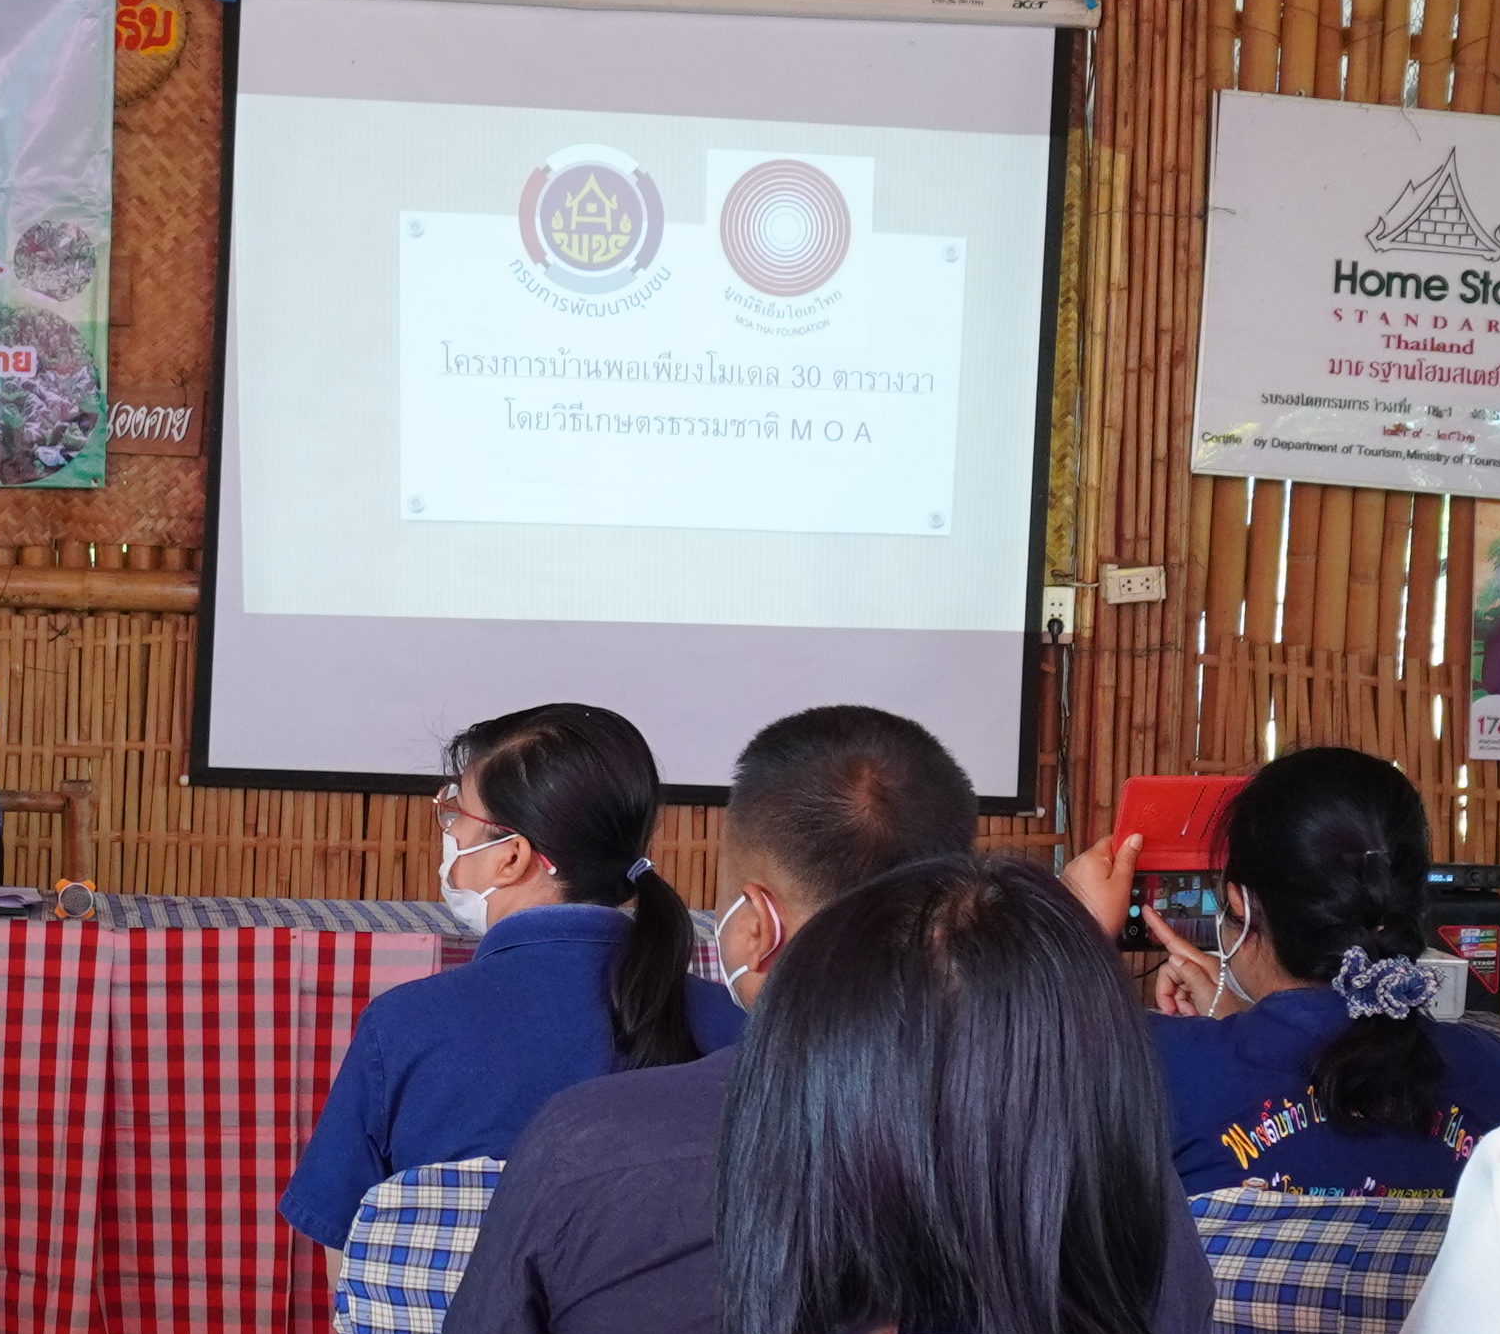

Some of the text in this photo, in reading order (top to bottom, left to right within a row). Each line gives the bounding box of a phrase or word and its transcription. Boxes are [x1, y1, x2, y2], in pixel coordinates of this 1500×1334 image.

[508, 256, 673, 317] กรมการพัฒนาชุมชน
[1333, 259, 1450, 303] Home
[1382, 333, 1475, 356] Thailand
[440, 340, 935, 395] โครงการบ้านพอเพียงโมเดล 30 ตารางวา
[504, 397, 780, 440] โดยวิธีเกษตรธรรมชาติ
[1201, 430, 1243, 447] Certifie
[1271, 437, 1338, 455] Department
[1341, 442, 1353, 455] of
[1453, 453, 1465, 466] of
